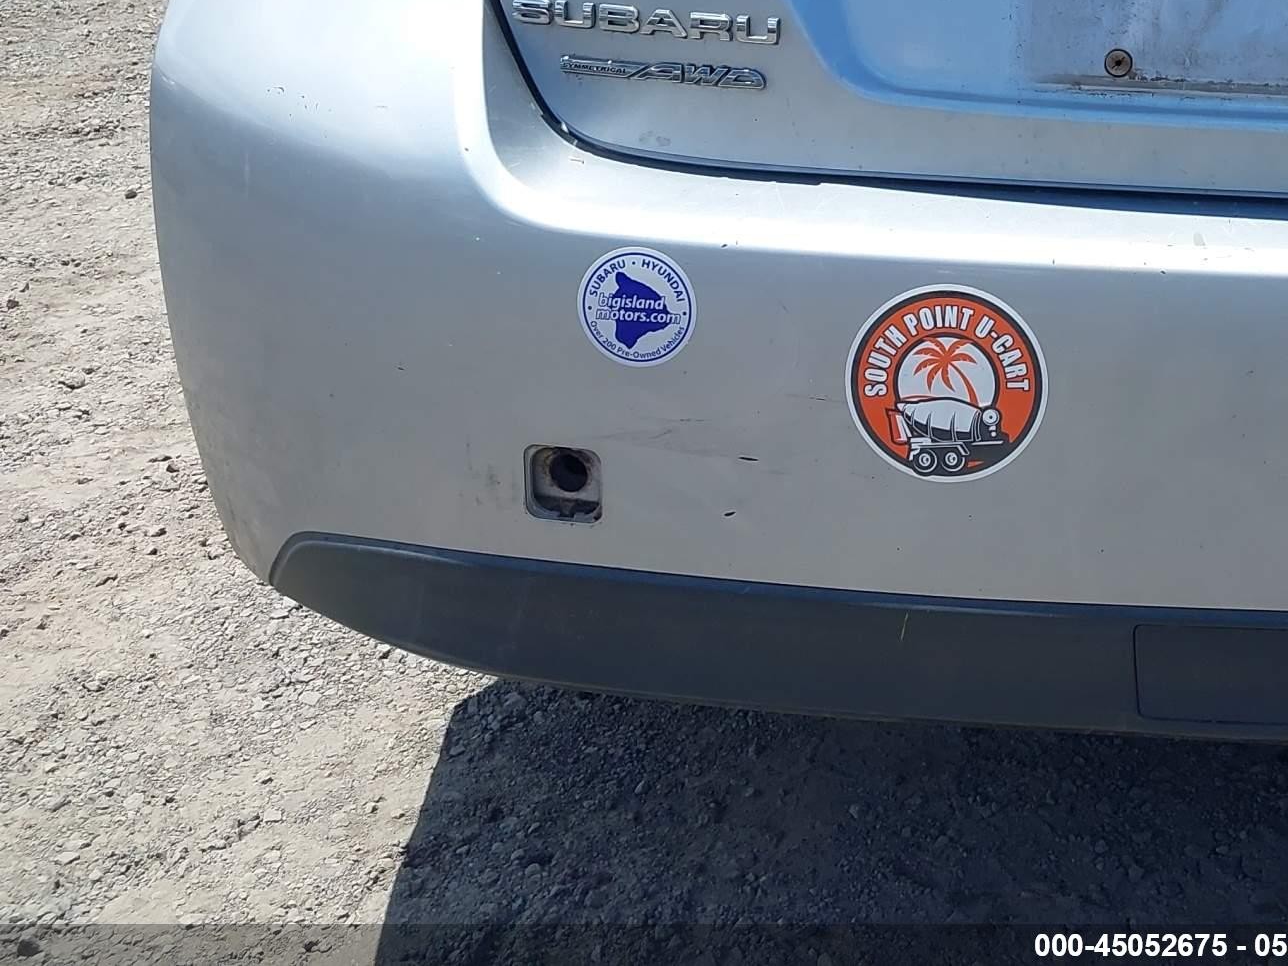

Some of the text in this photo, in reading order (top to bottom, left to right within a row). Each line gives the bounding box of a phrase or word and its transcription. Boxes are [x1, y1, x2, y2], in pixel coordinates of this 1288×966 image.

[563, 60, 767, 90] SYMMETRICAL AWD
[589, 258, 686, 302] SUBARU HYUNDAI
[595, 308, 682, 324] motors.com
[597, 292, 666, 310] bigisland
[590, 320, 685, 360] Over 200 Pre-Owned Vehicles
[863, 305, 1031, 398] SOUTH POINT U-CART
